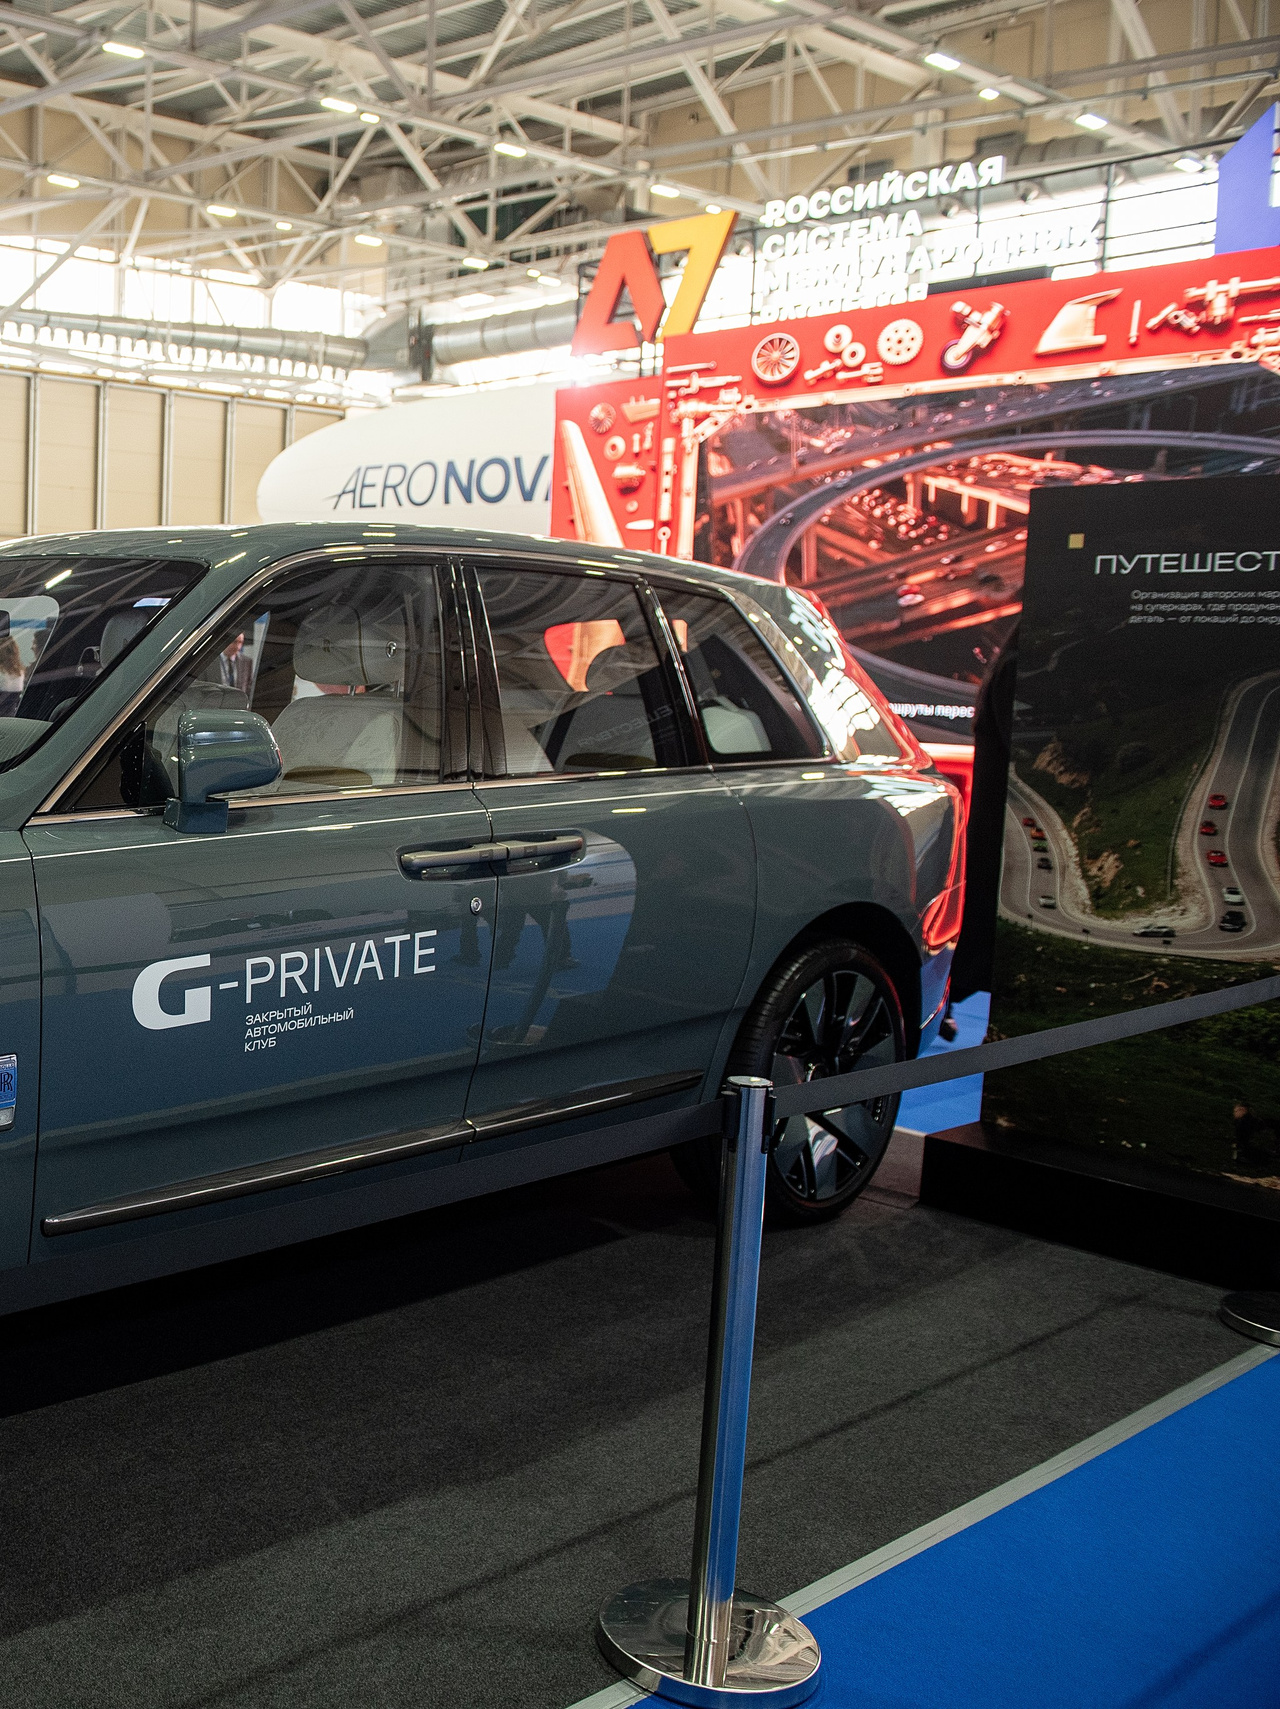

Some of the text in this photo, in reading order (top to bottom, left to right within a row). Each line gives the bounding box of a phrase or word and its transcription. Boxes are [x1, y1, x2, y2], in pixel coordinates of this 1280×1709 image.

[762, 155, 1004, 228] РОССИЙСКАЯ
[761, 209, 924, 262] СИСТЕМА
[325, 455, 552, 510] AERONOV
[1131, 589, 1200, 600] Организация
[1201, 591, 1256, 600] авторских
[131, 929, 438, 1030] G-PRIVATE
[244, 1007, 354, 1039] АВТОМОБИЛЬНЫЙ
[245, 1002, 313, 1026] ЗАКРЫТЫЙ
[244, 1037, 277, 1052] КЛУБ
